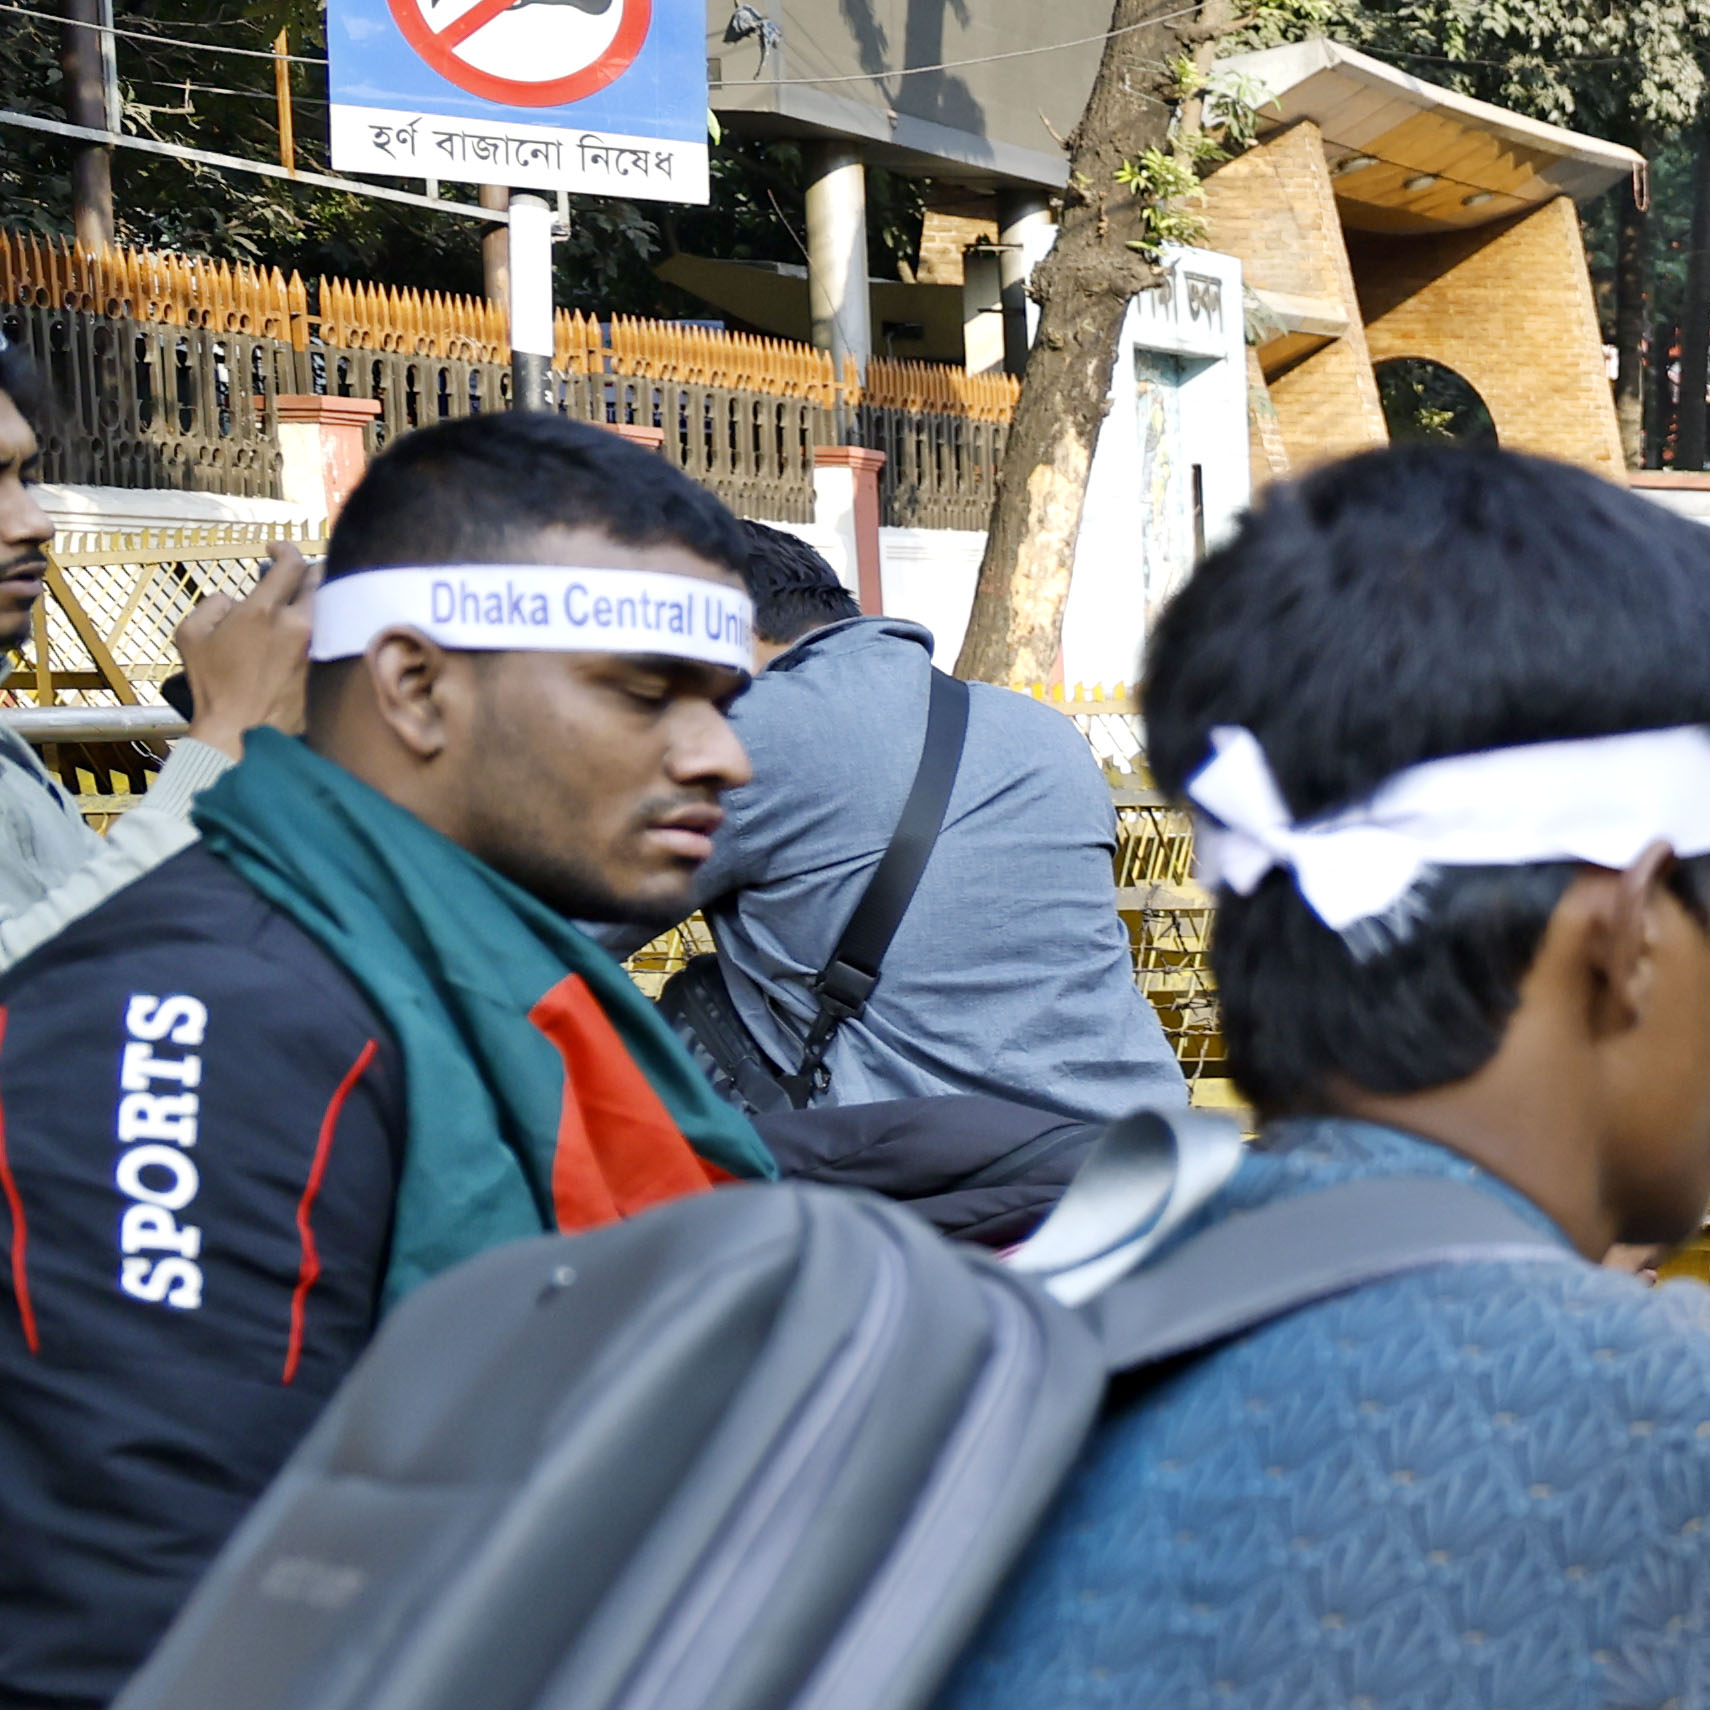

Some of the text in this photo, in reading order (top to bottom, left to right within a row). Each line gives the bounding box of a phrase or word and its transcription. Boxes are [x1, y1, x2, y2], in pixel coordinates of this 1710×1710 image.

[368, 117, 674, 181] হর্ণ বাজানো নিষেধ
[430, 579, 550, 627] Dhaka
[562, 582, 694, 637] Central
[114, 992, 207, 1309] SPORTS
